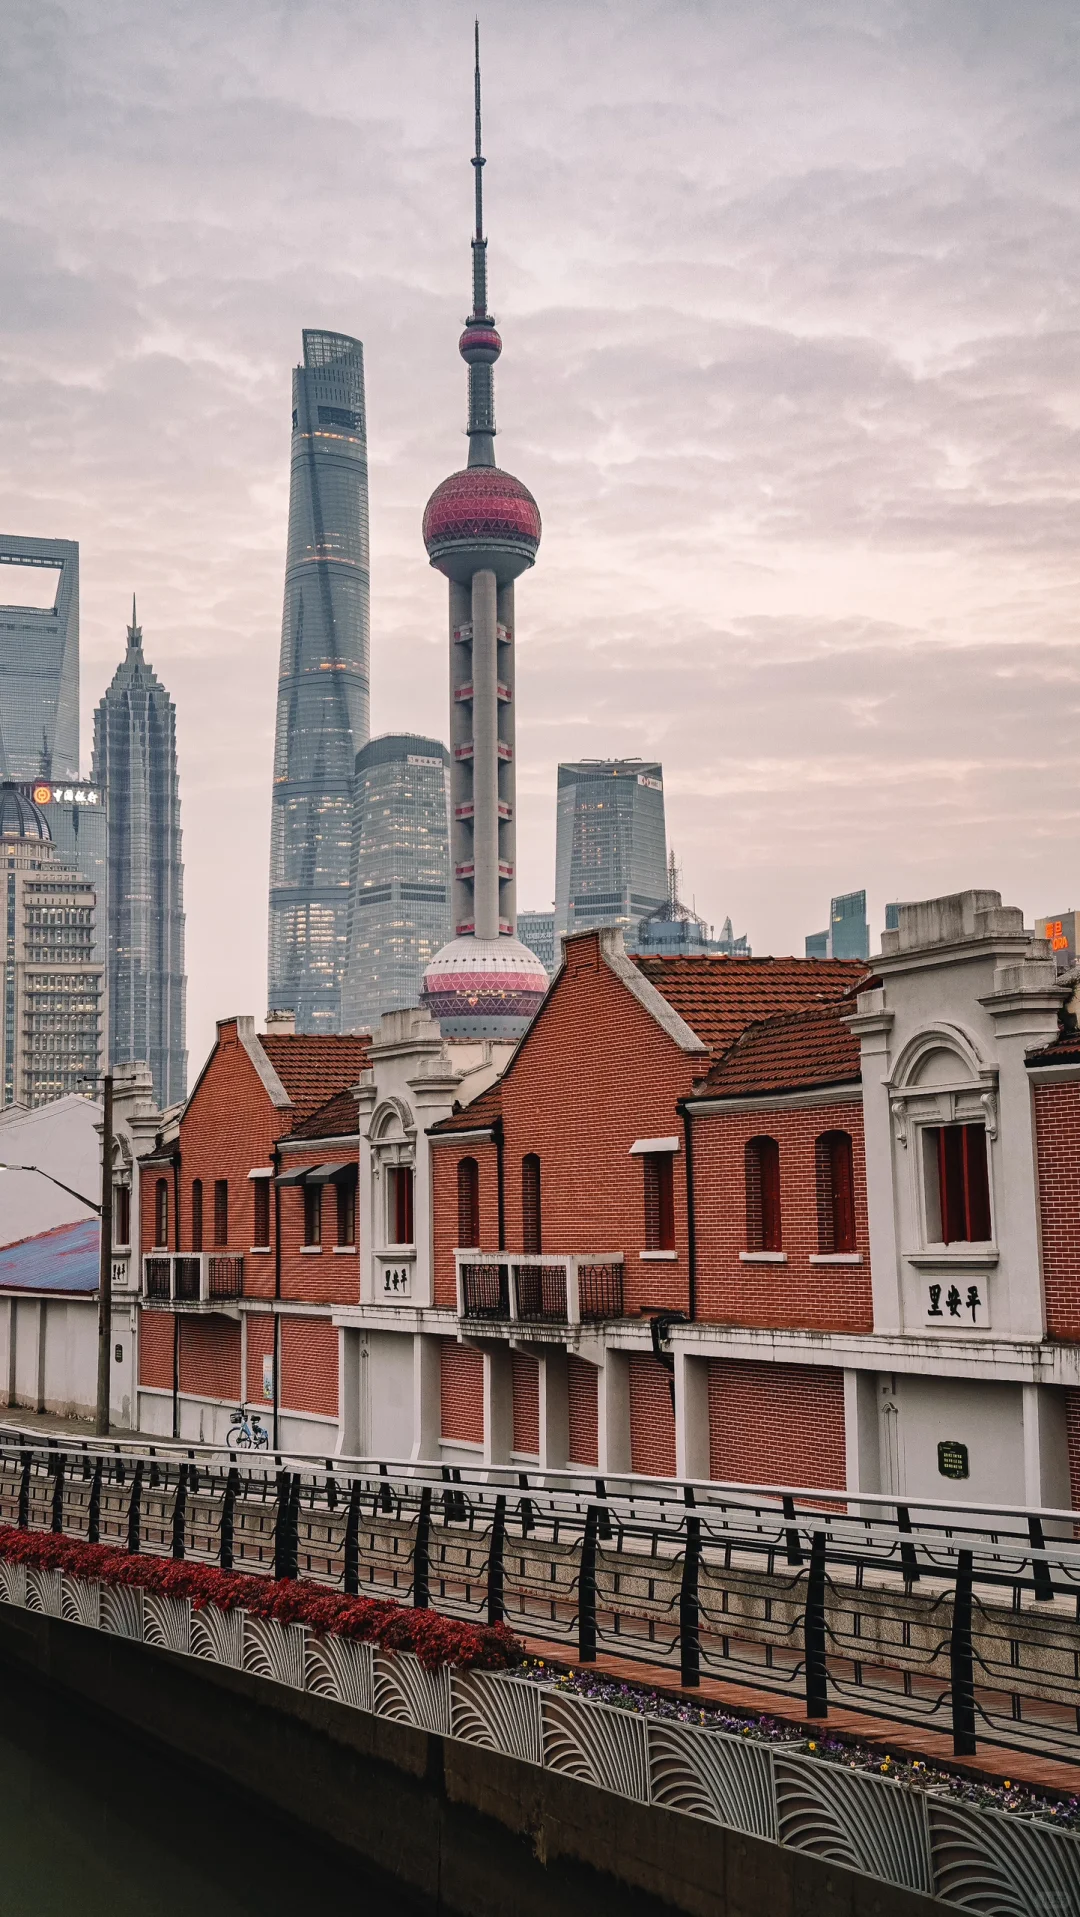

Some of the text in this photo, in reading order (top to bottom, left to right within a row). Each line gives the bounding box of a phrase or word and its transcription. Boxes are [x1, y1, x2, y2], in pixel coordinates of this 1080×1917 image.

[53, 789, 99, 804] 中国银行
[1053, 936, 1069, 952] ORA
